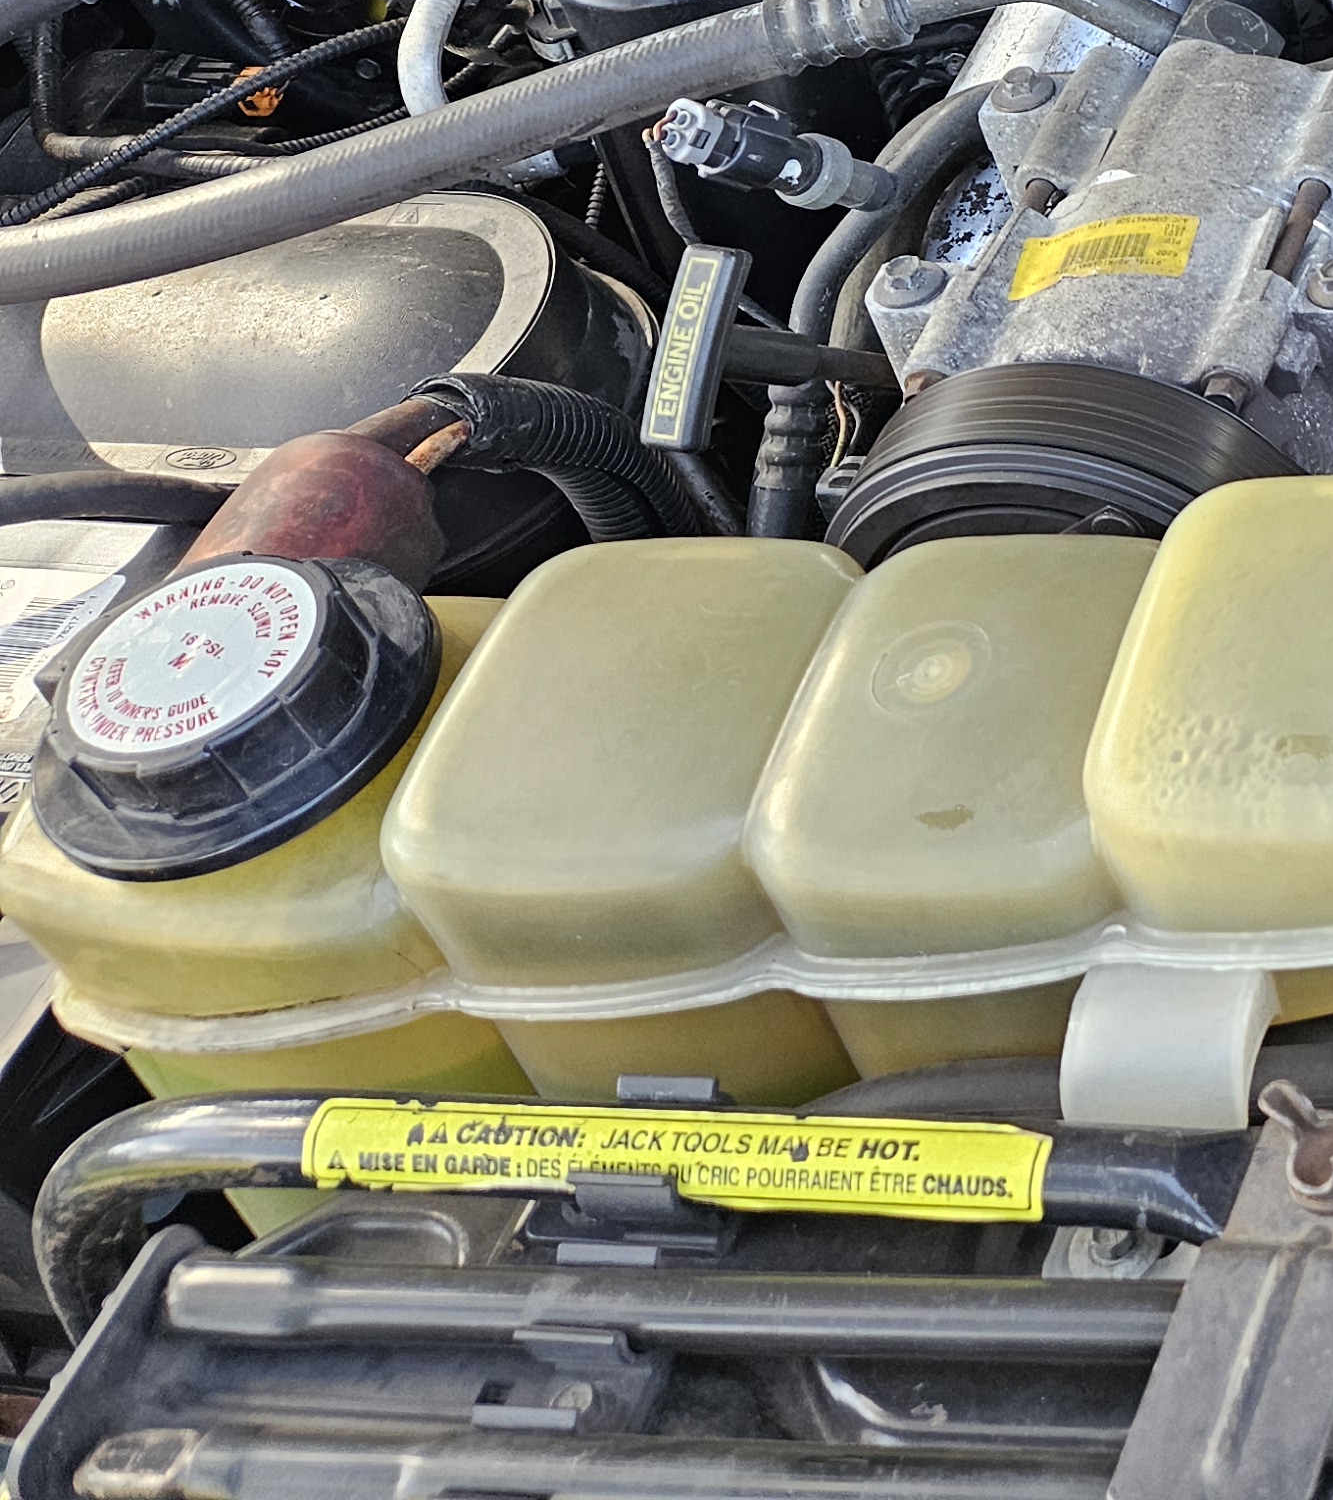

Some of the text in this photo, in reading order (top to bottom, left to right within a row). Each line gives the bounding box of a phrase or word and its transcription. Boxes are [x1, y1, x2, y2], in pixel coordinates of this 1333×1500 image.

[567, 17, 719, 73] GOODYEAR
[656, 281, 708, 418] ENGINE OIL
[135, 575, 299, 679] WARNING DO NOT OPEN HOT
[180, 631, 200, 647] 16
[189, 592, 273, 640] REMOVE SLOWLY
[77, 656, 108, 719] CONTENTS
[104, 657, 209, 722] REFER TO OWNER'S GUIDE
[88, 712, 131, 743] UNDER
[131, 706, 220, 743] PRESSURE
[456, 1119, 587, 1148] CAUTION:
[600, 1129, 673, 1151] JACK
[672, 1130, 754, 1156] TOOLS
[815, 1137, 852, 1159] BE
[857, 1139, 920, 1162] HOT.
[358, 1151, 405, 1172] MISE
[411, 1151, 439, 1174] EN
[526, 1159, 561, 1179] DES
[697, 1164, 739, 1186] CRIC
[746, 1167, 865, 1193] POURRAIENT
[870, 1166, 917, 1194] ÊTRE
[922, 1176, 1014, 1199] CHAUDS.
